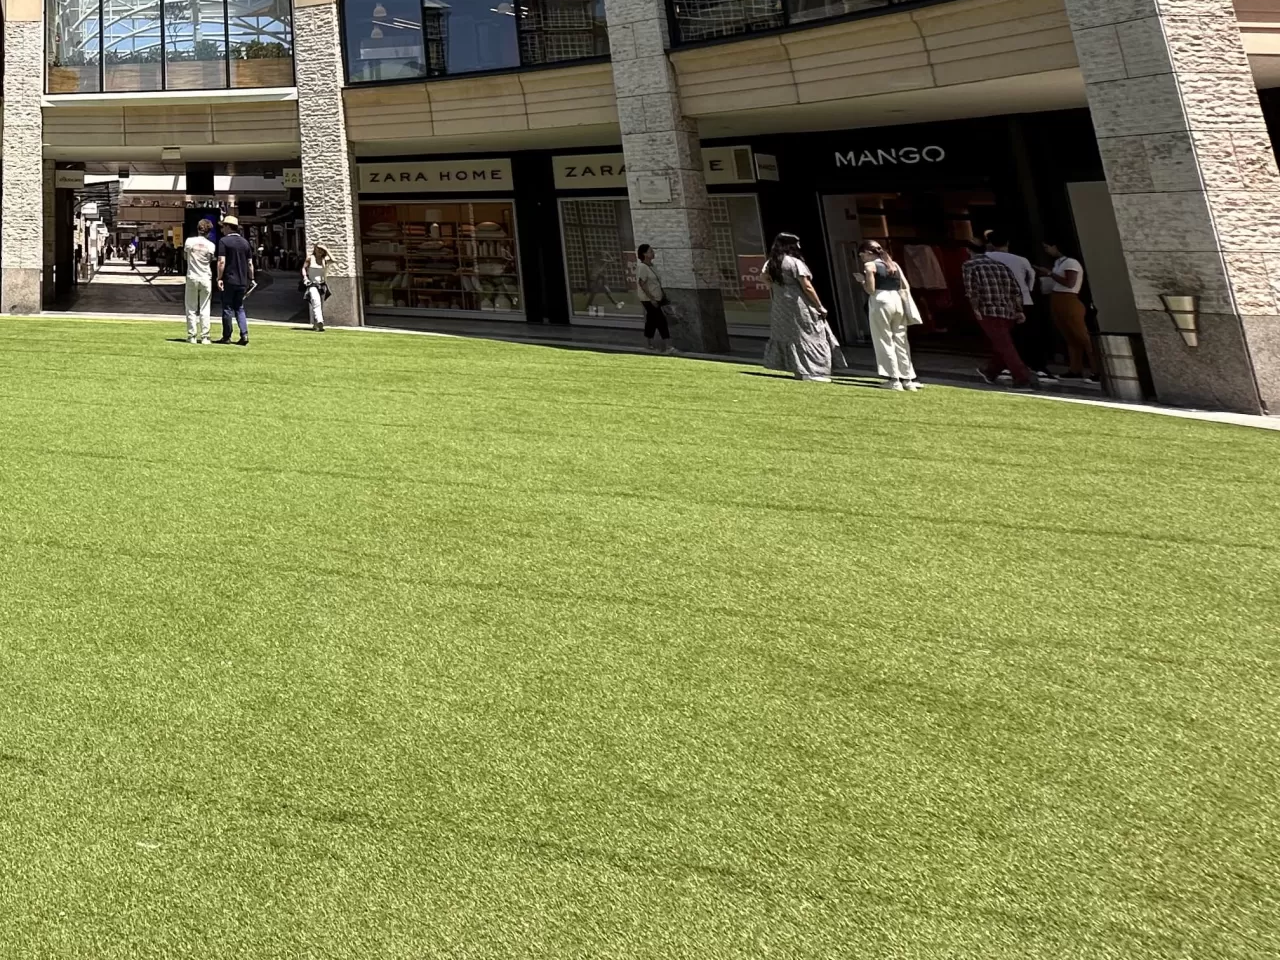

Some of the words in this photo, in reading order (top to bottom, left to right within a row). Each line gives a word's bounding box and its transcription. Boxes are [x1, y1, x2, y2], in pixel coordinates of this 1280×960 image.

[834, 145, 945, 168] MANGO
[369, 171, 428, 183] ZARA
[439, 169, 503, 182] HOME
